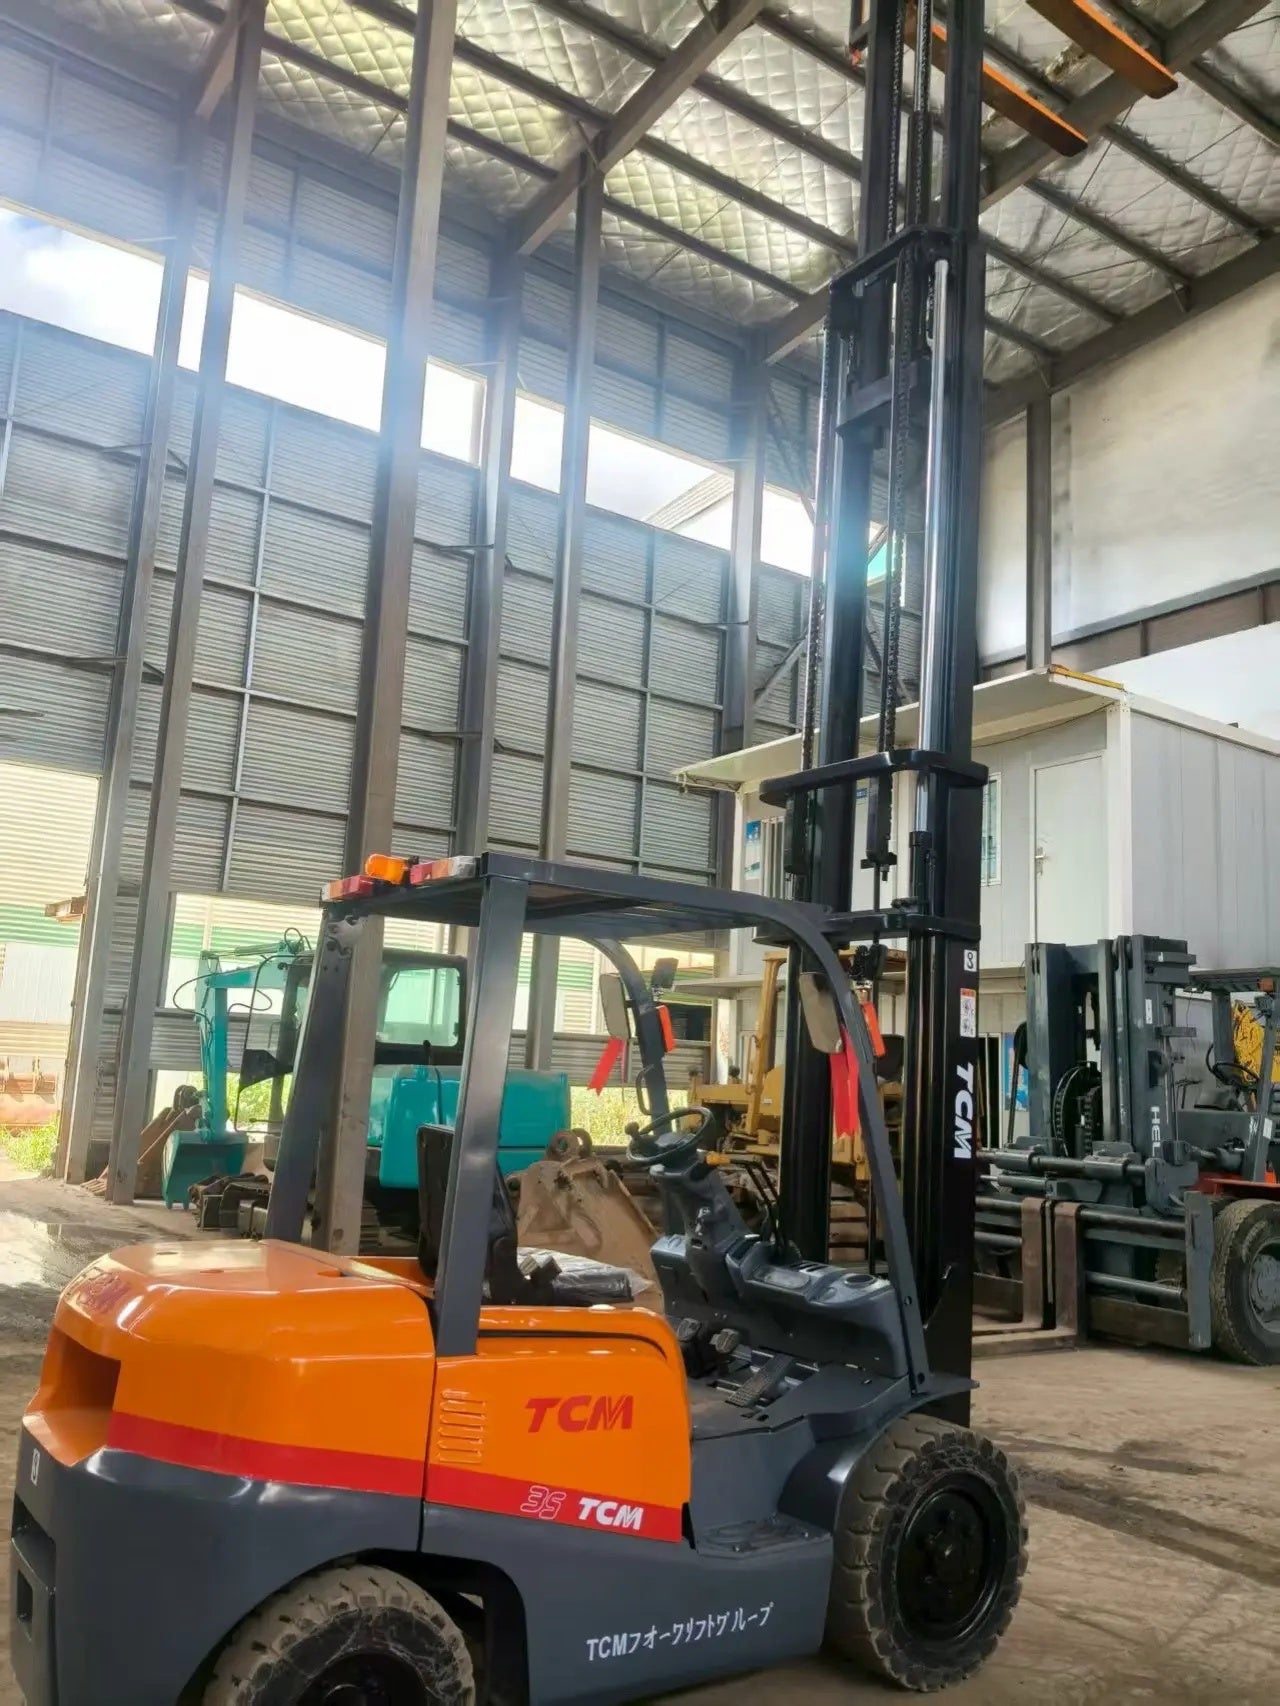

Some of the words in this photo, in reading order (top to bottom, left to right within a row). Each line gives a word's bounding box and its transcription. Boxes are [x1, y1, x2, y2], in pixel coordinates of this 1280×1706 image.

[954, 1062, 974, 1159] TCM
[526, 1395, 634, 1433] TCM
[578, 1497, 644, 1530] TCM
